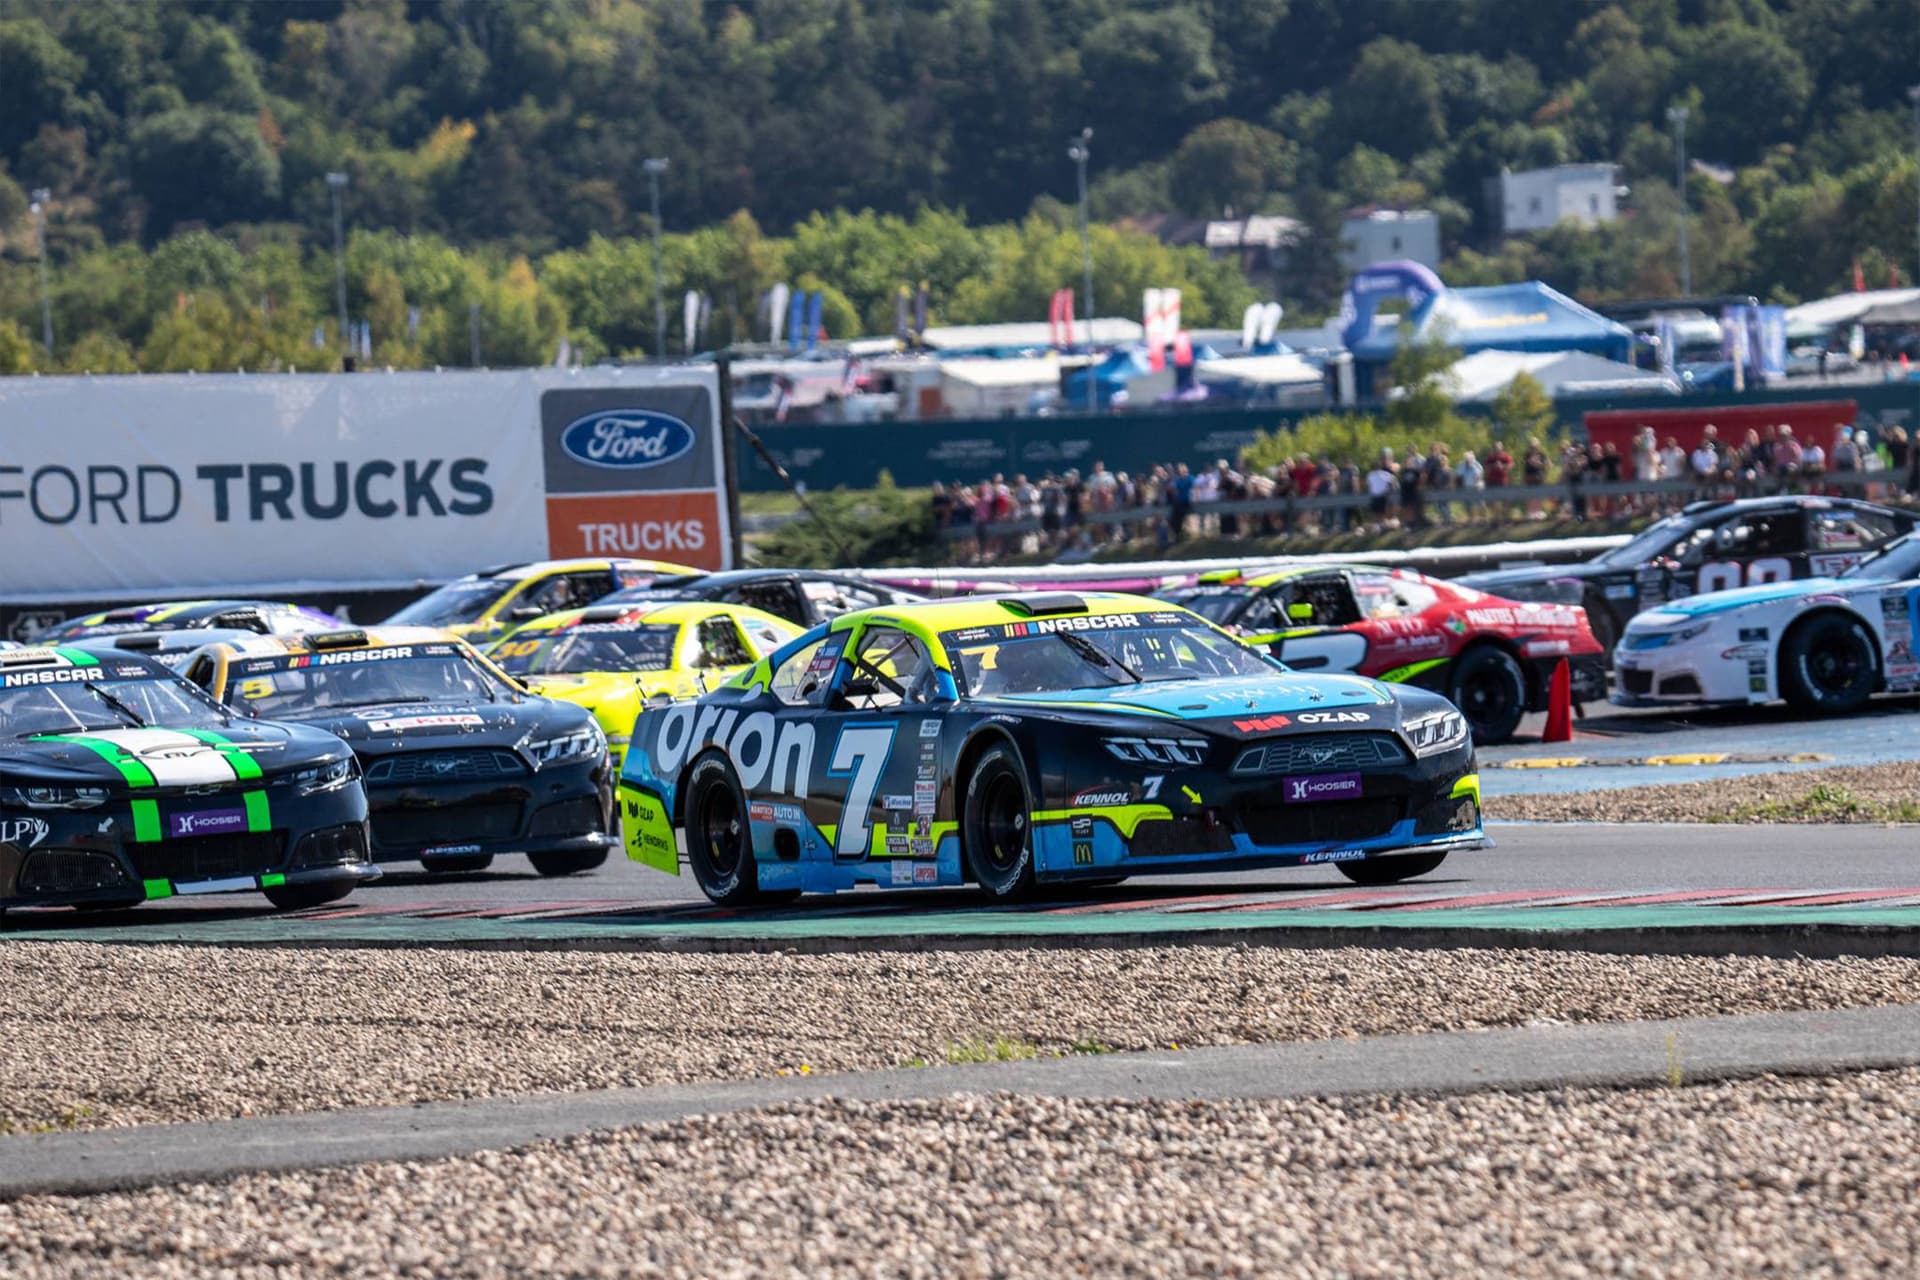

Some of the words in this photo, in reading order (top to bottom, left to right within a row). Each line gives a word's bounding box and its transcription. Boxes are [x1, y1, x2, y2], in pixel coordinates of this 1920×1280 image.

[587, 417, 670, 461] Ford
[197, 458, 494, 522] TRUCKS
[579, 520, 706, 554] TRUCKS
[1038, 614, 1140, 634] NASCAR
[319, 646, 413, 665] NASCAR
[960, 645, 1001, 671] 7
[5, 667, 105, 687] NASCAR
[242, 678, 275, 699] 5
[1297, 711, 1371, 724] OZAP
[830, 724, 896, 859] 7
[1142, 774, 1165, 800] 7
[1308, 780, 1356, 793] HOOSIER
[1074, 791, 1130, 805] KENNOL
[193, 814, 242, 828] HOOSIER
[1304, 849, 1366, 863] KENNOL
